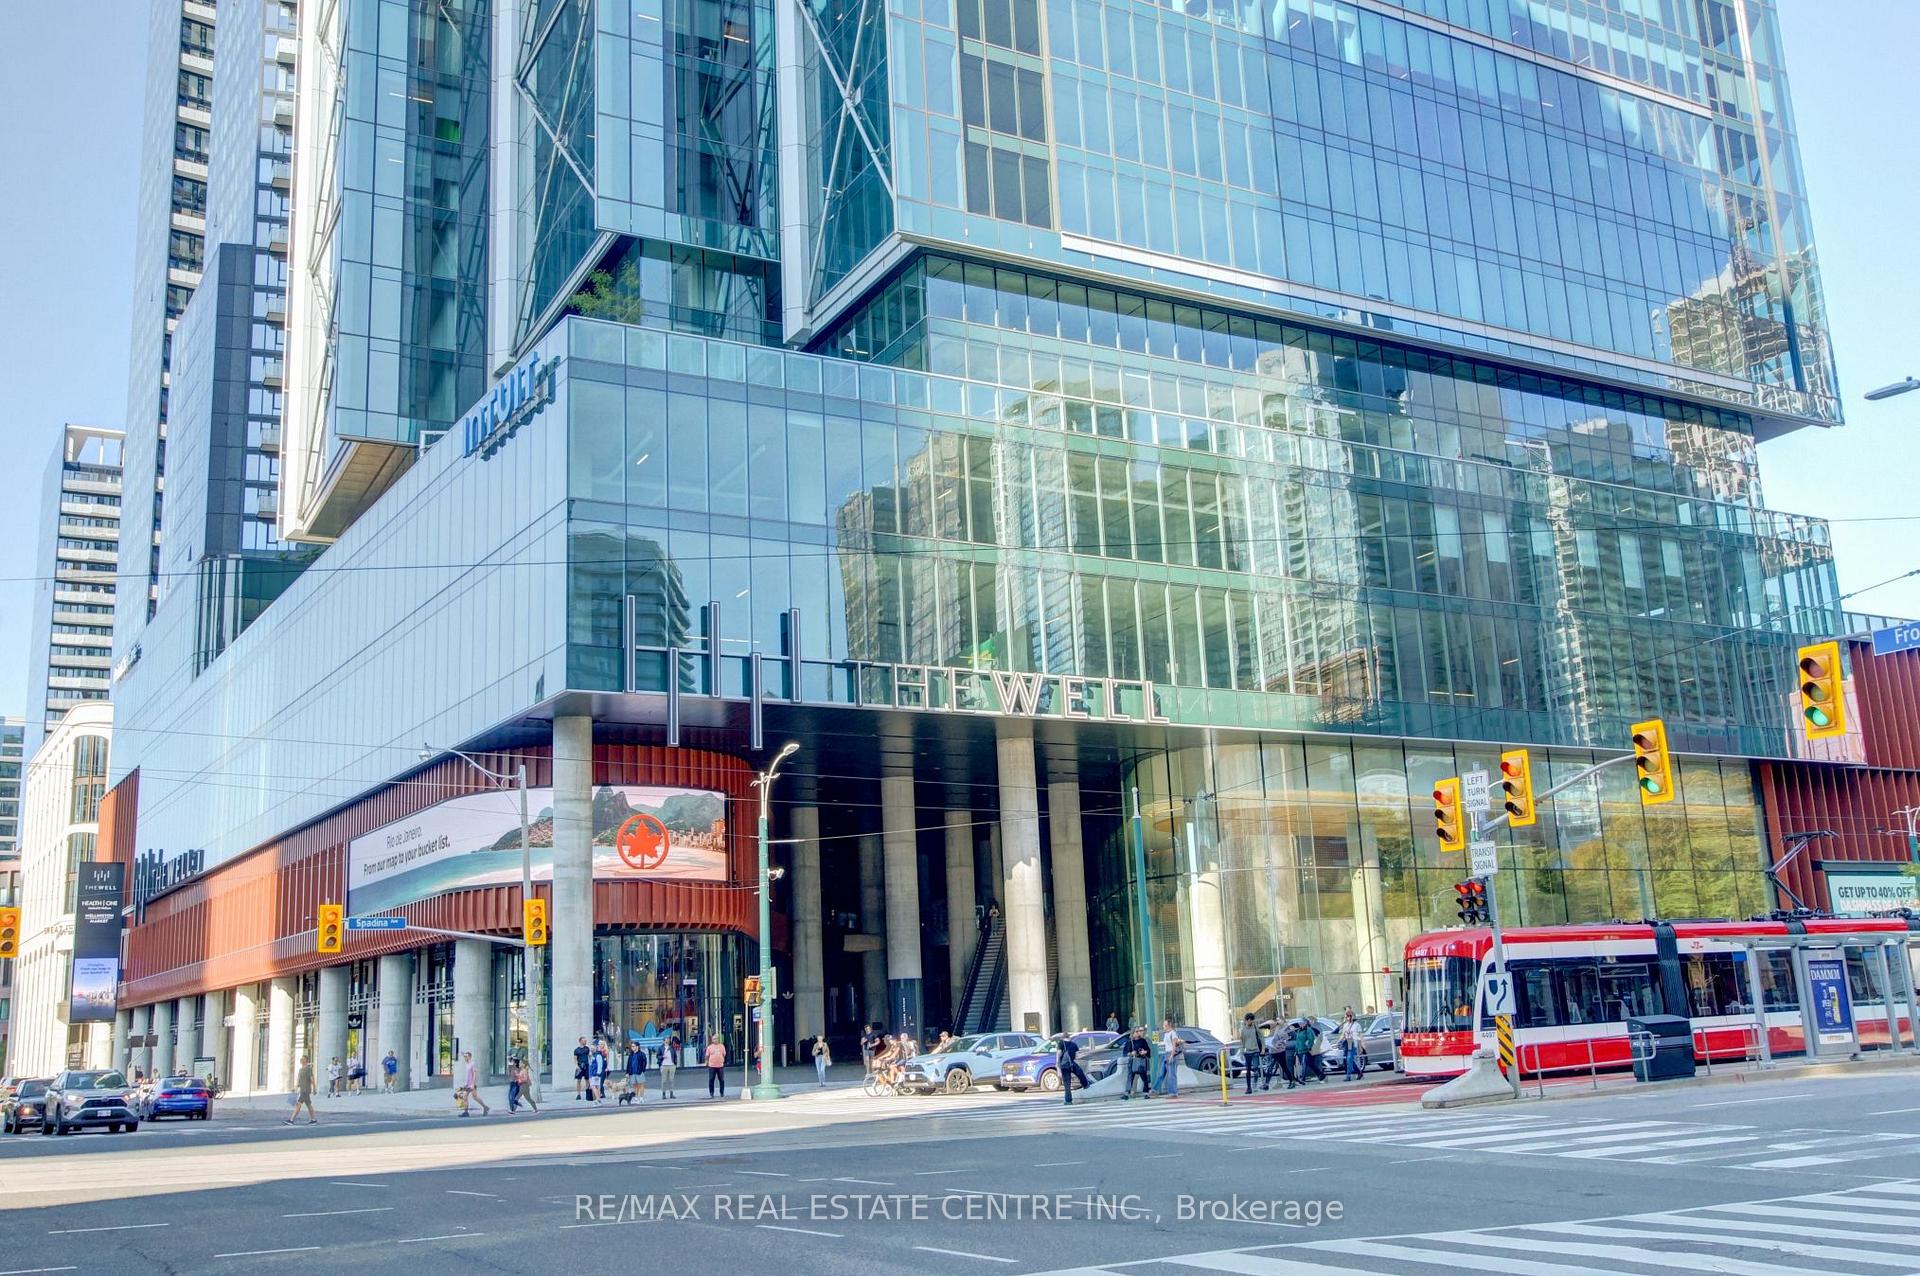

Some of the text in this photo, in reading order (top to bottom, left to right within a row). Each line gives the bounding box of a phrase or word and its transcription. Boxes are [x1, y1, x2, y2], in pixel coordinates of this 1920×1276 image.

[842, 658, 1170, 725] THE WELL
[1466, 775, 1483, 785] LEFT
[1467, 786, 1486, 796] TURN
[1467, 798, 1488, 808] SIGNAL
[387, 836, 395, 848] Rio
[364, 834, 450, 877] From our map to your bucket list.
[1472, 846, 1494, 858] TRANSIT
[1474, 861, 1495, 871] SIGNAL
[1838, 886, 1912, 898] GET UP TO 40% OFF
[356, 919, 388, 928] Spadina
